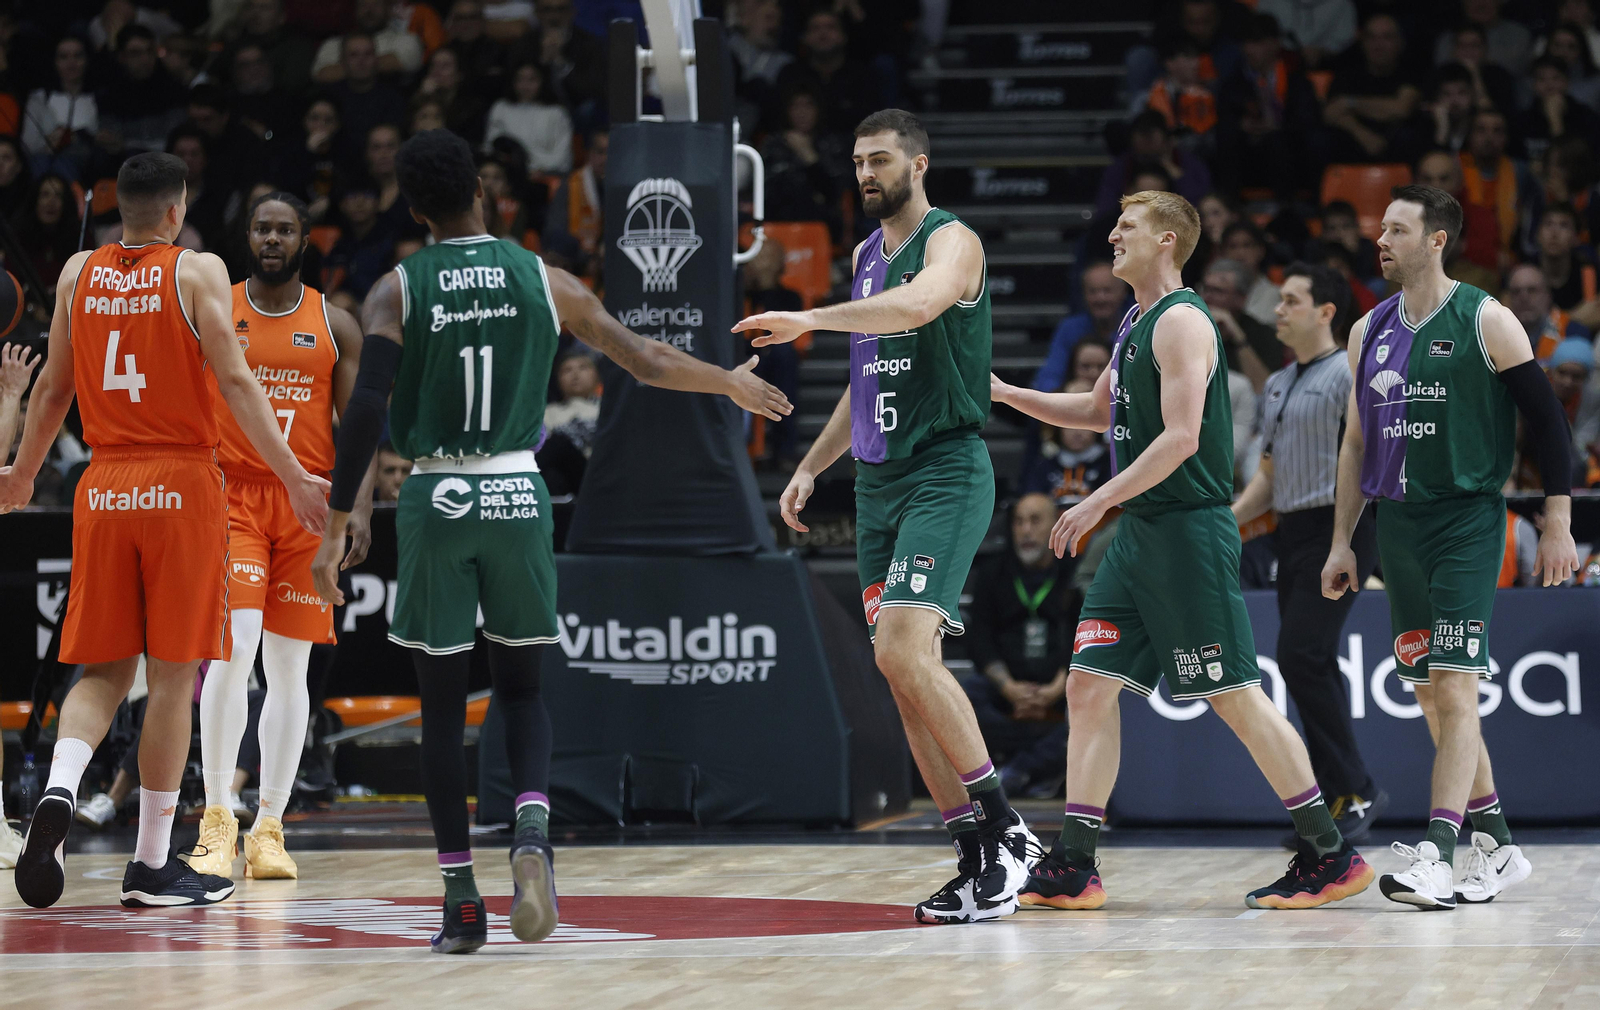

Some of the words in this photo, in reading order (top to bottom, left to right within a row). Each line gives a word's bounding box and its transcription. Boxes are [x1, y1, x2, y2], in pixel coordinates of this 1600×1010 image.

[90, 266, 162, 292] PRADILLA
[439, 266, 506, 292] CARTER
[85, 294, 161, 315] PAMESA
[618, 302, 703, 327] valencia
[103, 331, 146, 403] 4
[252, 365, 300, 382] ultura
[300, 375, 314, 384] del
[262, 381, 312, 401] uerza
[459, 345, 493, 432] 11
[874, 391, 898, 433] 45
[479, 477, 535, 493] COSTA
[1399, 456, 1408, 493] 4
[480, 495, 509, 507] DEL
[511, 493, 538, 506] SOL
[480, 507, 539, 520] MÁLAGA
[283, 590, 321, 605] Midea
[1433, 631, 1464, 651] laga
[669, 661, 776, 685] SPORT
[1176, 661, 1204, 679] laga
